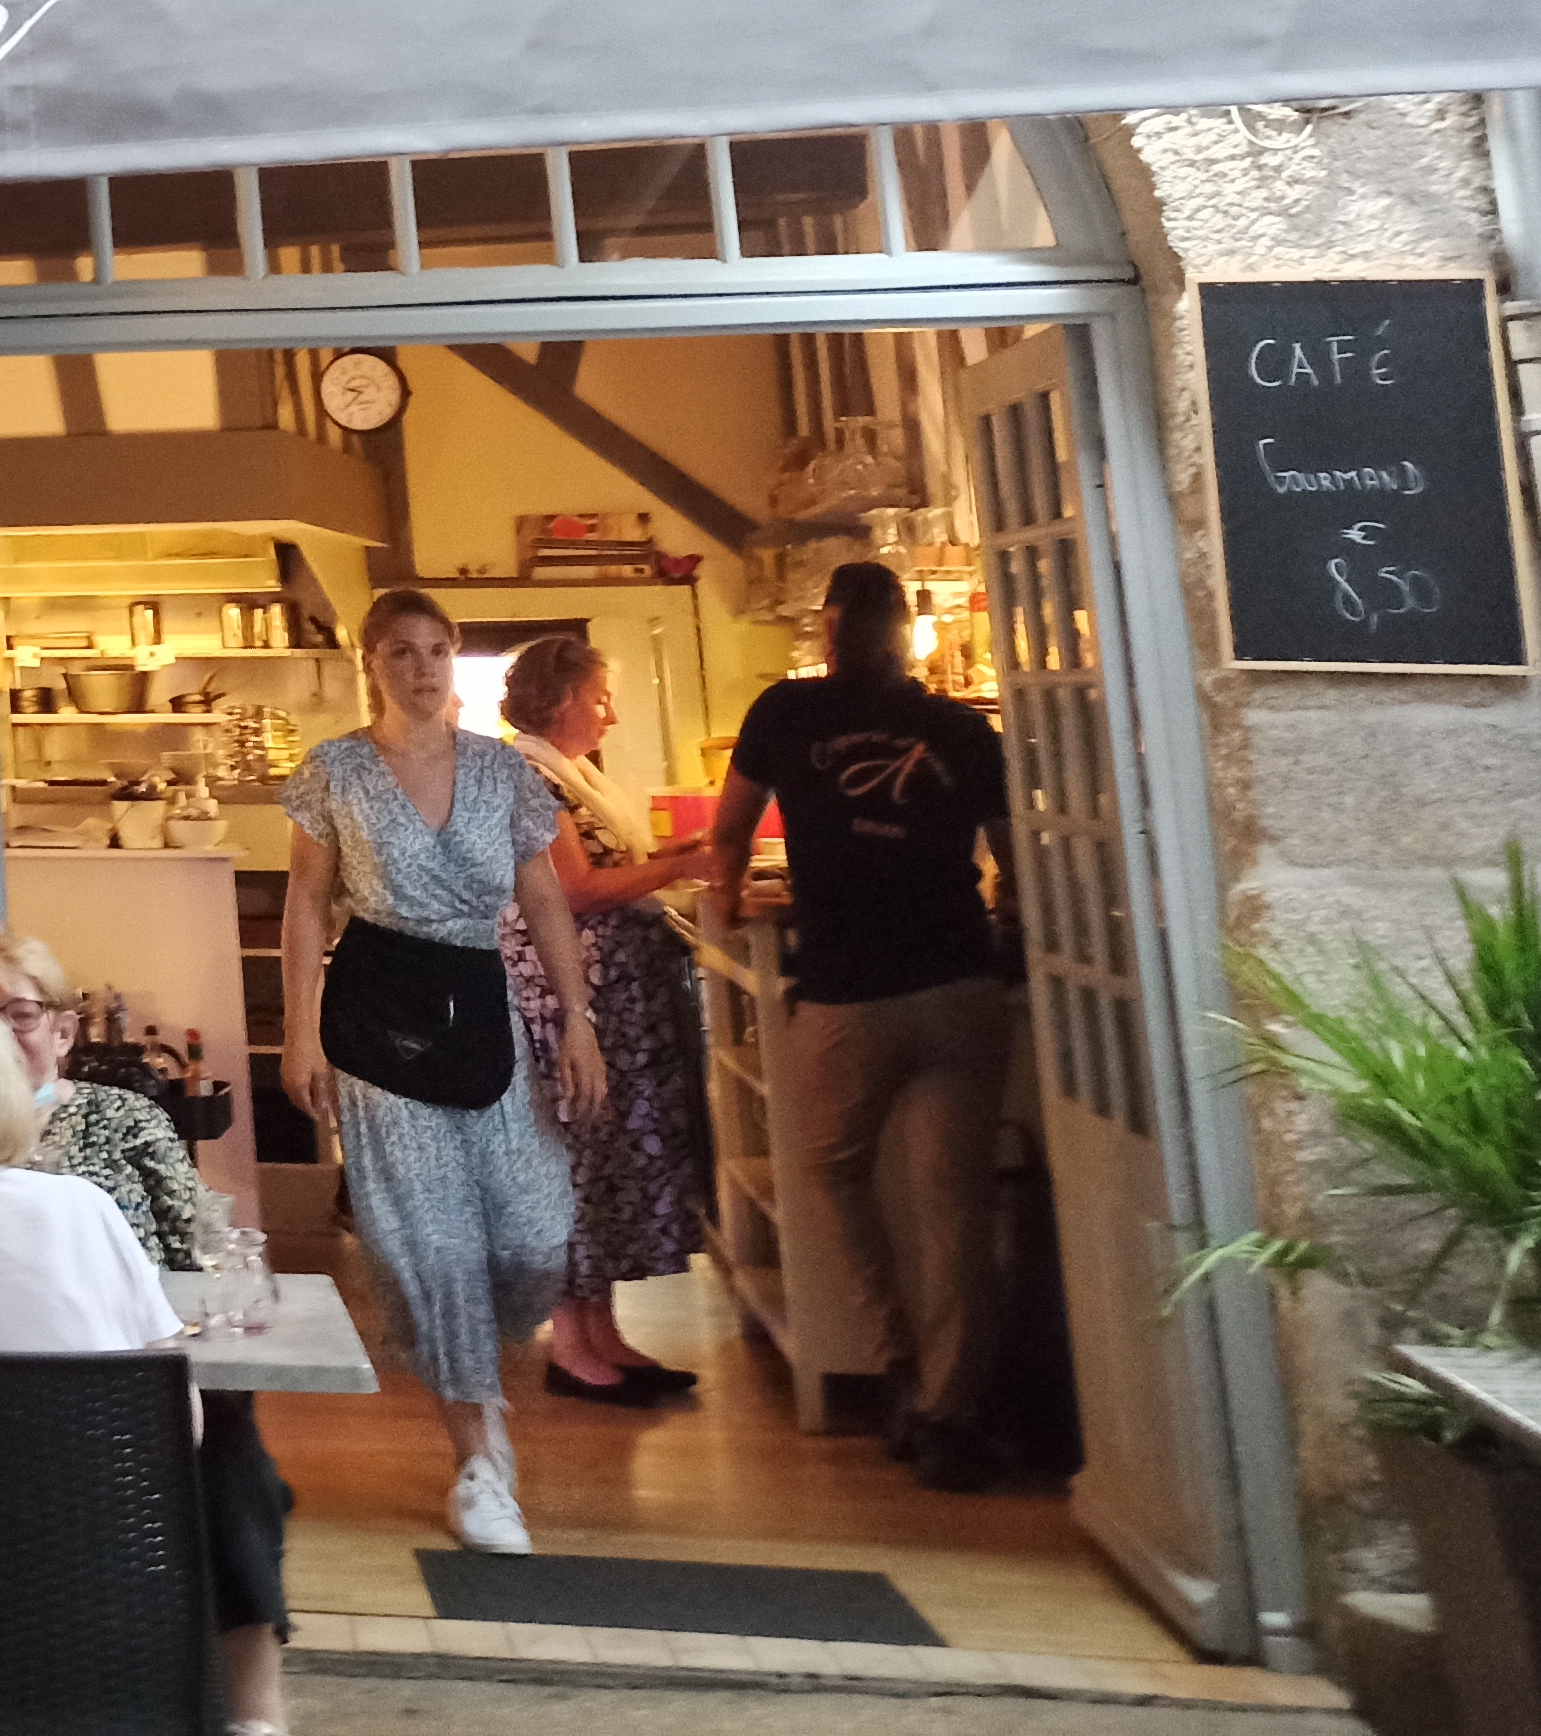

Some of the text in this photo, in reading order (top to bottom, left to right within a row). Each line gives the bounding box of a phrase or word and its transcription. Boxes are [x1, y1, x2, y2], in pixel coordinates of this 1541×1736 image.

[1248, 319, 1395, 387] CAFÉ
[1341, 521, 1387, 545] €
[1326, 558, 1443, 634] 8,50
